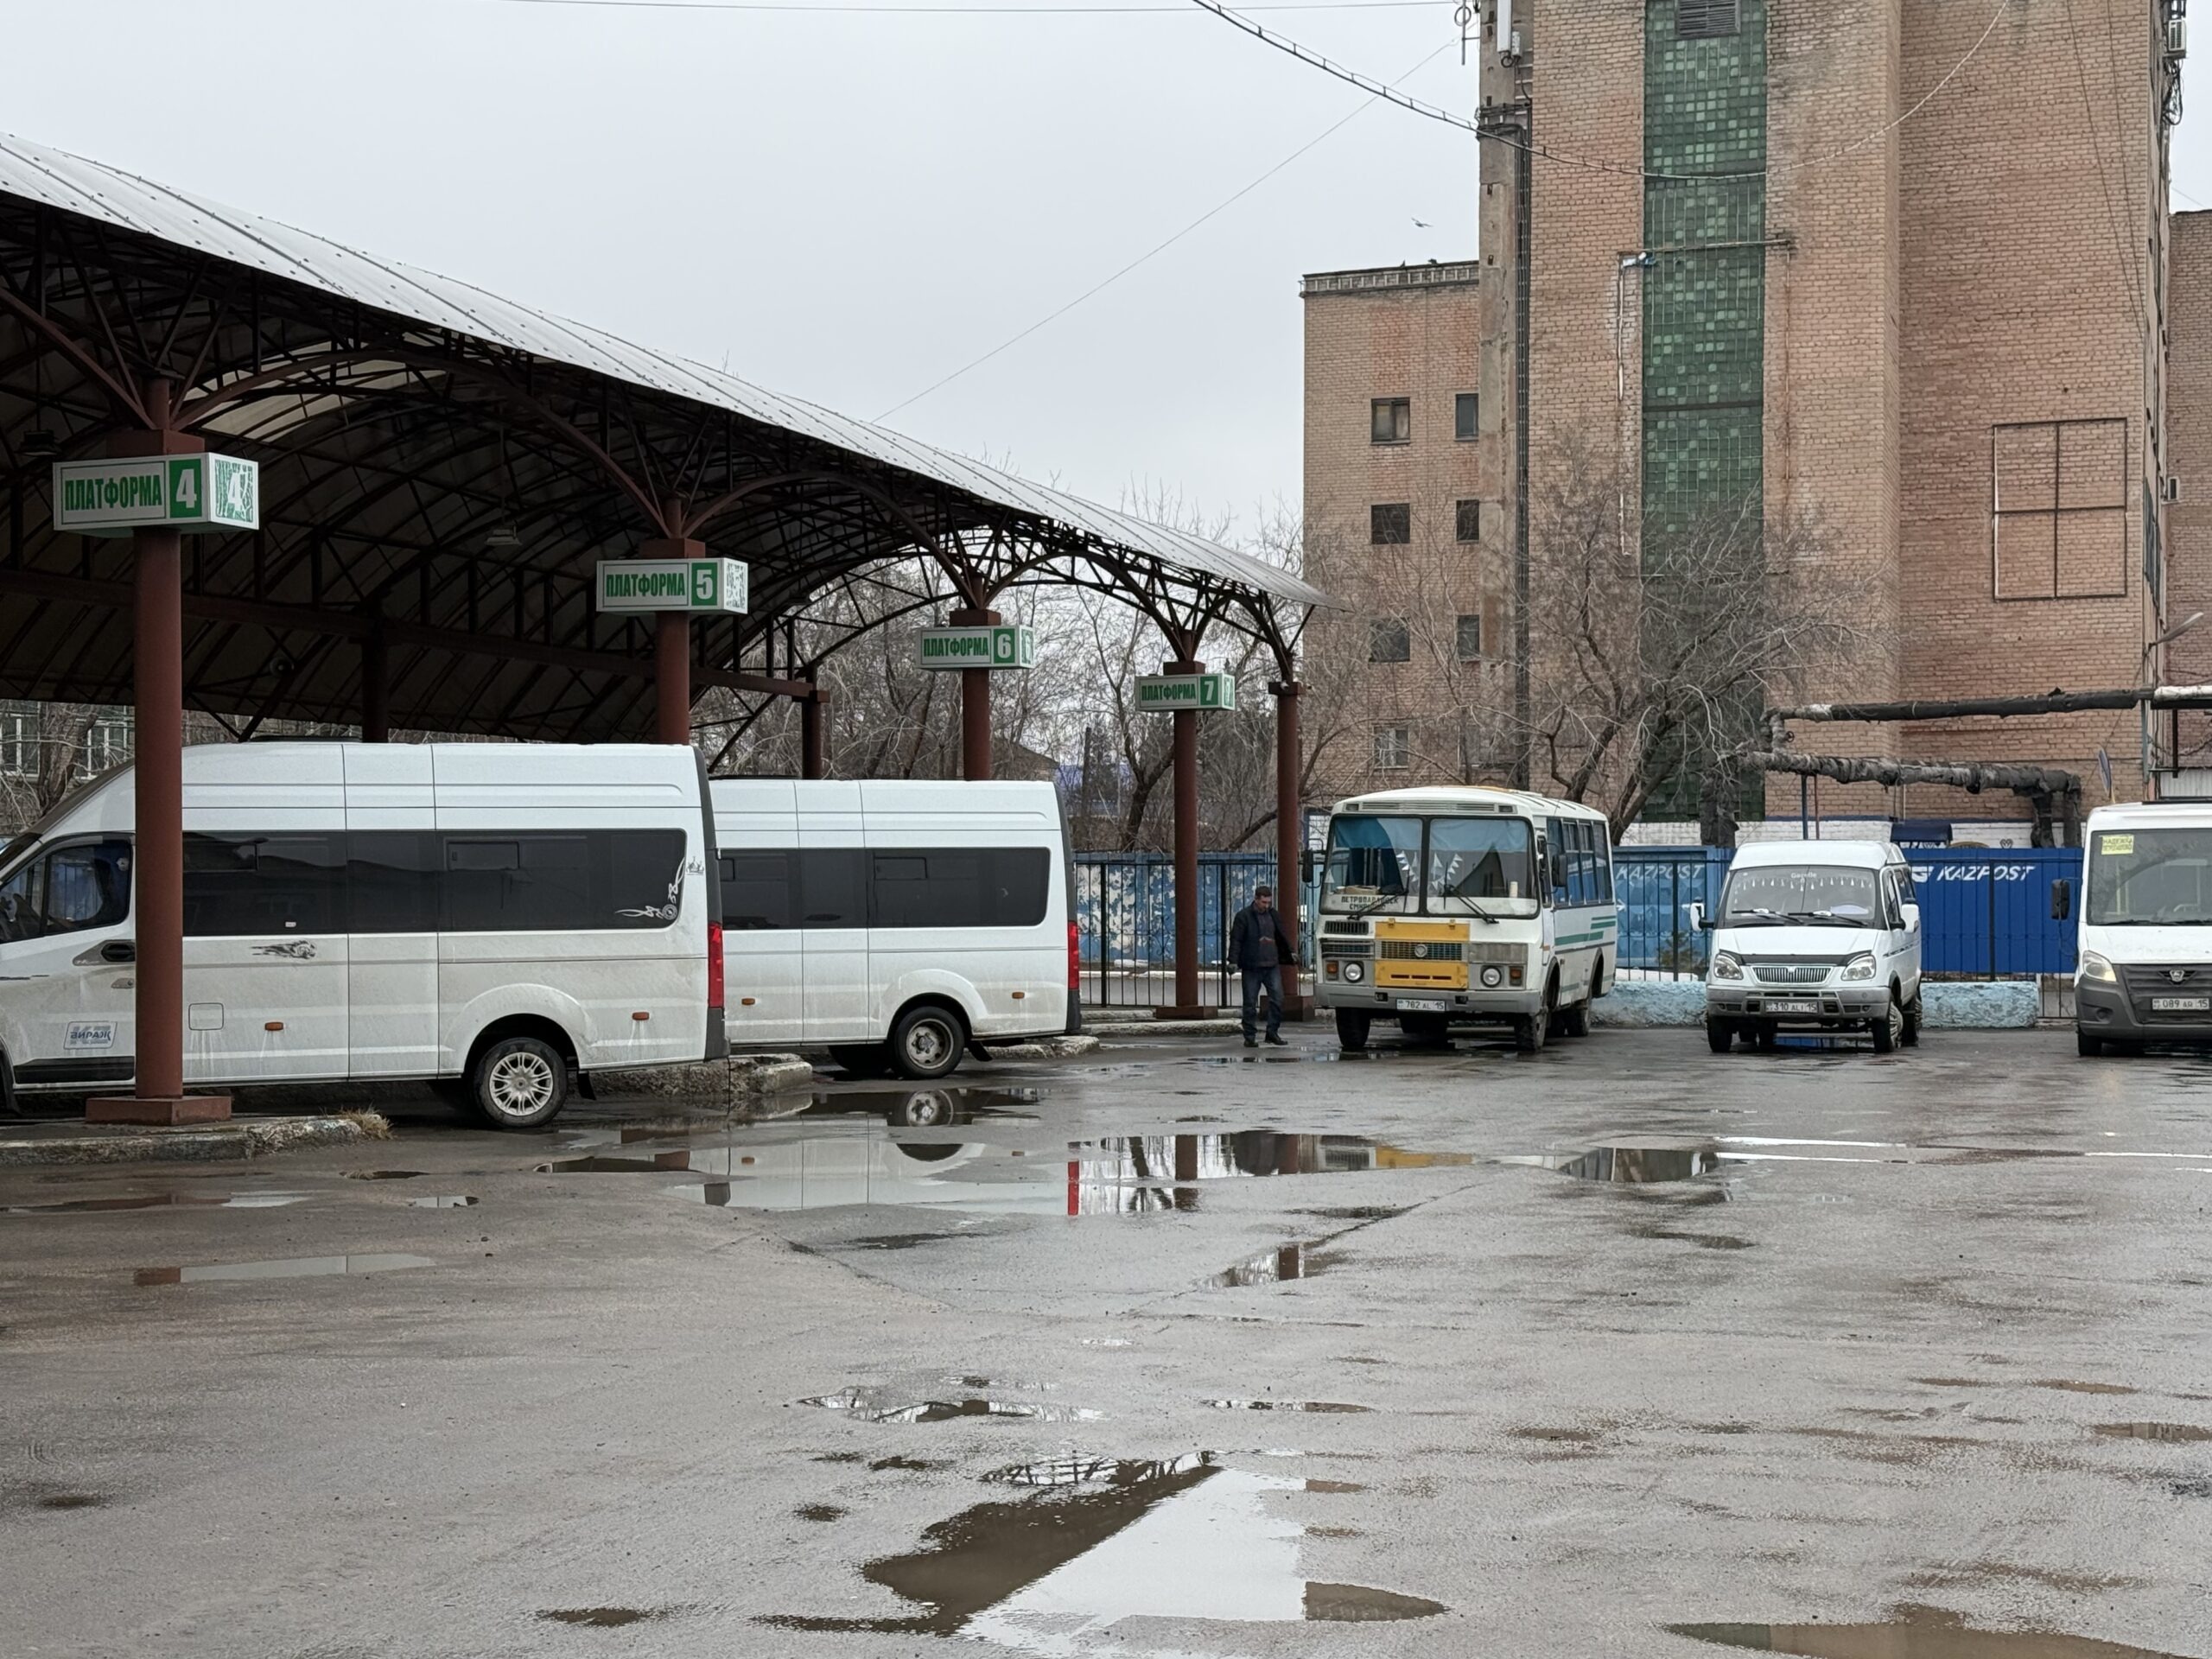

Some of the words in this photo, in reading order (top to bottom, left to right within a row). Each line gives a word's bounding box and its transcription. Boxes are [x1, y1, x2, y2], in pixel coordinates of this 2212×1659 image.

[64, 474, 162, 511] ПЛАТФОРМА
[175, 467, 198, 509] 4
[606, 572, 686, 598] ПЛАТФОРМА
[696, 569, 714, 600] 5
[923, 637, 988, 657] ПЛАТФОРМА
[996, 632, 1012, 659] 6
[1141, 683, 1197, 702] ПЛАТФОРМА
[1204, 680, 1215, 702] 7
[1615, 864, 1706, 880] KAZPOST
[1936, 865, 2036, 881] KAZPOST
[1434, 1001, 1445, 1010] 15
[1806, 1002, 1817, 1011] 15
[2162, 999, 2180, 1008] 089
[2198, 999, 2209, 1008] 15
